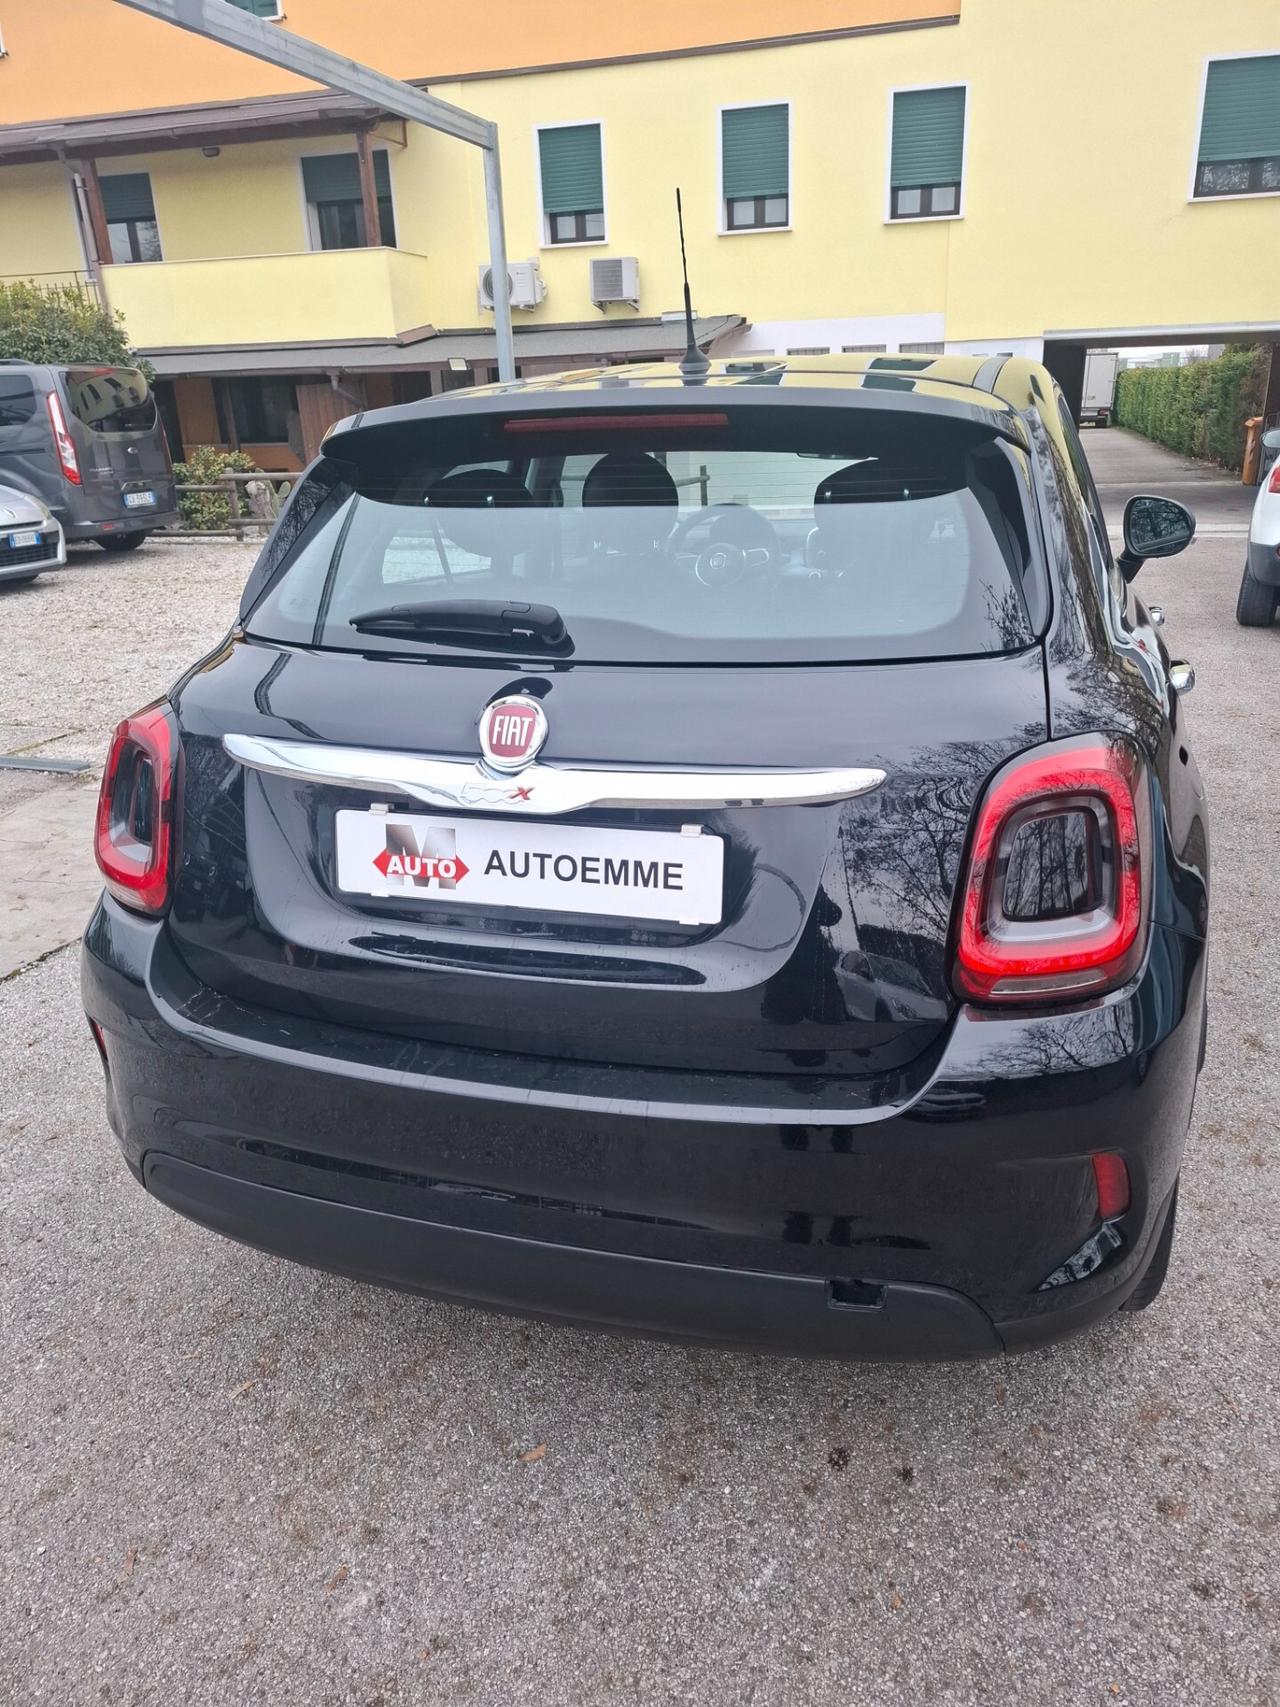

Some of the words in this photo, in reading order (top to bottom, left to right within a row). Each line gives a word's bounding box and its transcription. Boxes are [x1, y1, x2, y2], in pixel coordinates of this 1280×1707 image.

[492, 715, 534, 747] FIAT
[386, 855, 457, 878] AUTO
[484, 849, 684, 891] AUTOEMME
